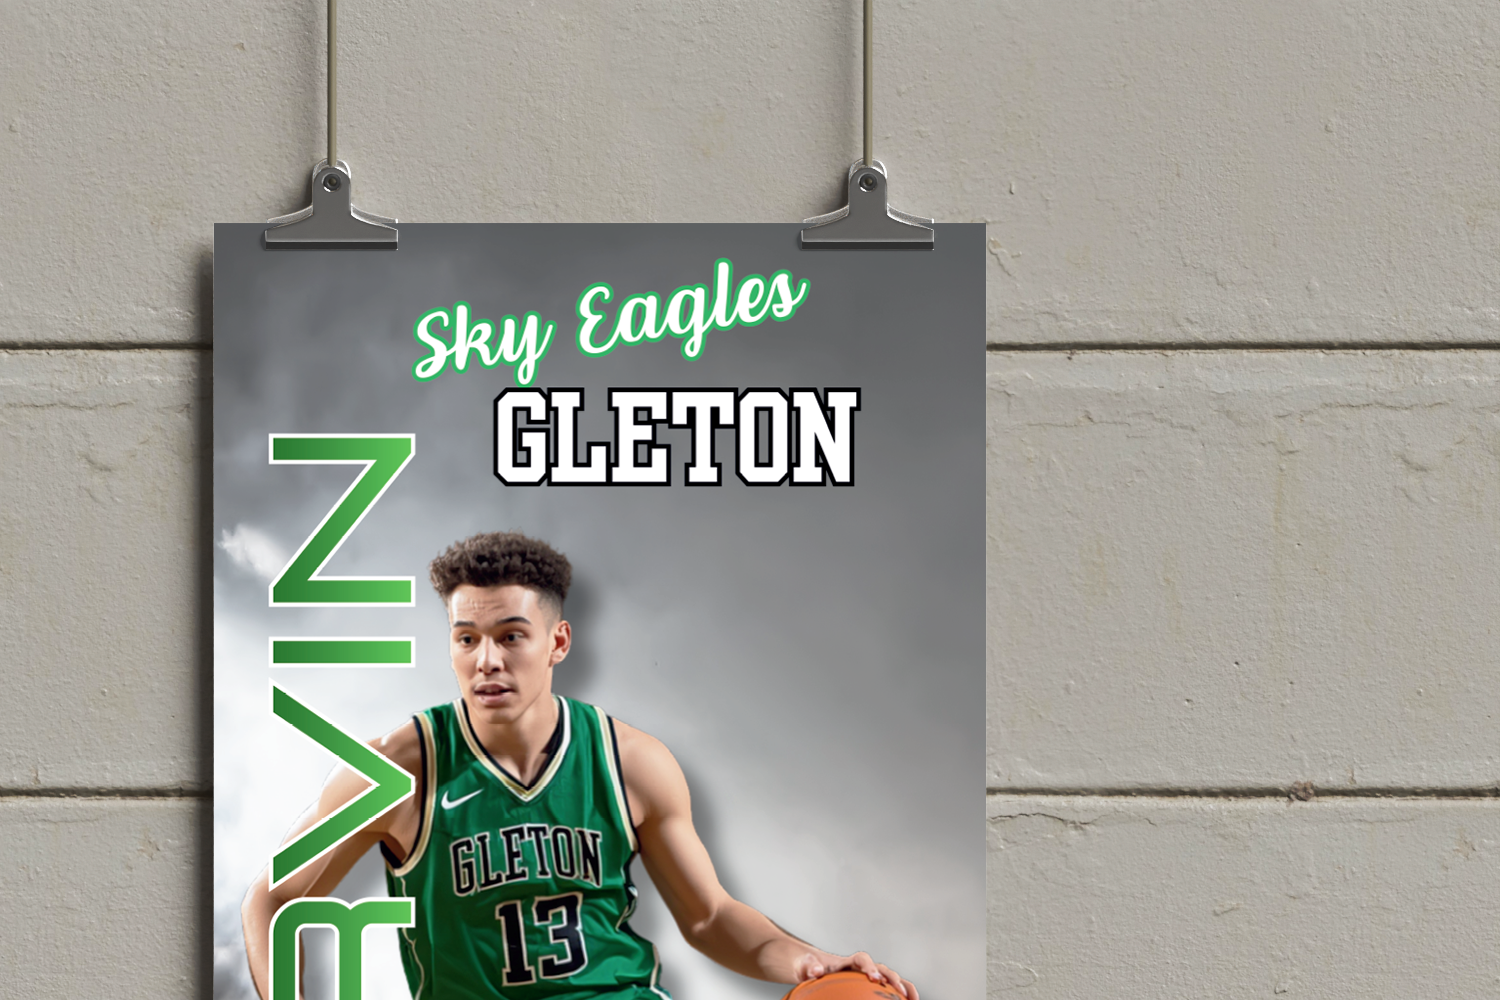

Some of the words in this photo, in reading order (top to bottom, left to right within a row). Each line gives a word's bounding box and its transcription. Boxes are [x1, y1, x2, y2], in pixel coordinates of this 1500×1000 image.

[413, 302, 557, 386] Sky
[576, 257, 810, 361] Eagles
[493, 387, 861, 487] GLETON
[450, 823, 602, 897] GLETON
[495, 891, 588, 987] 13
